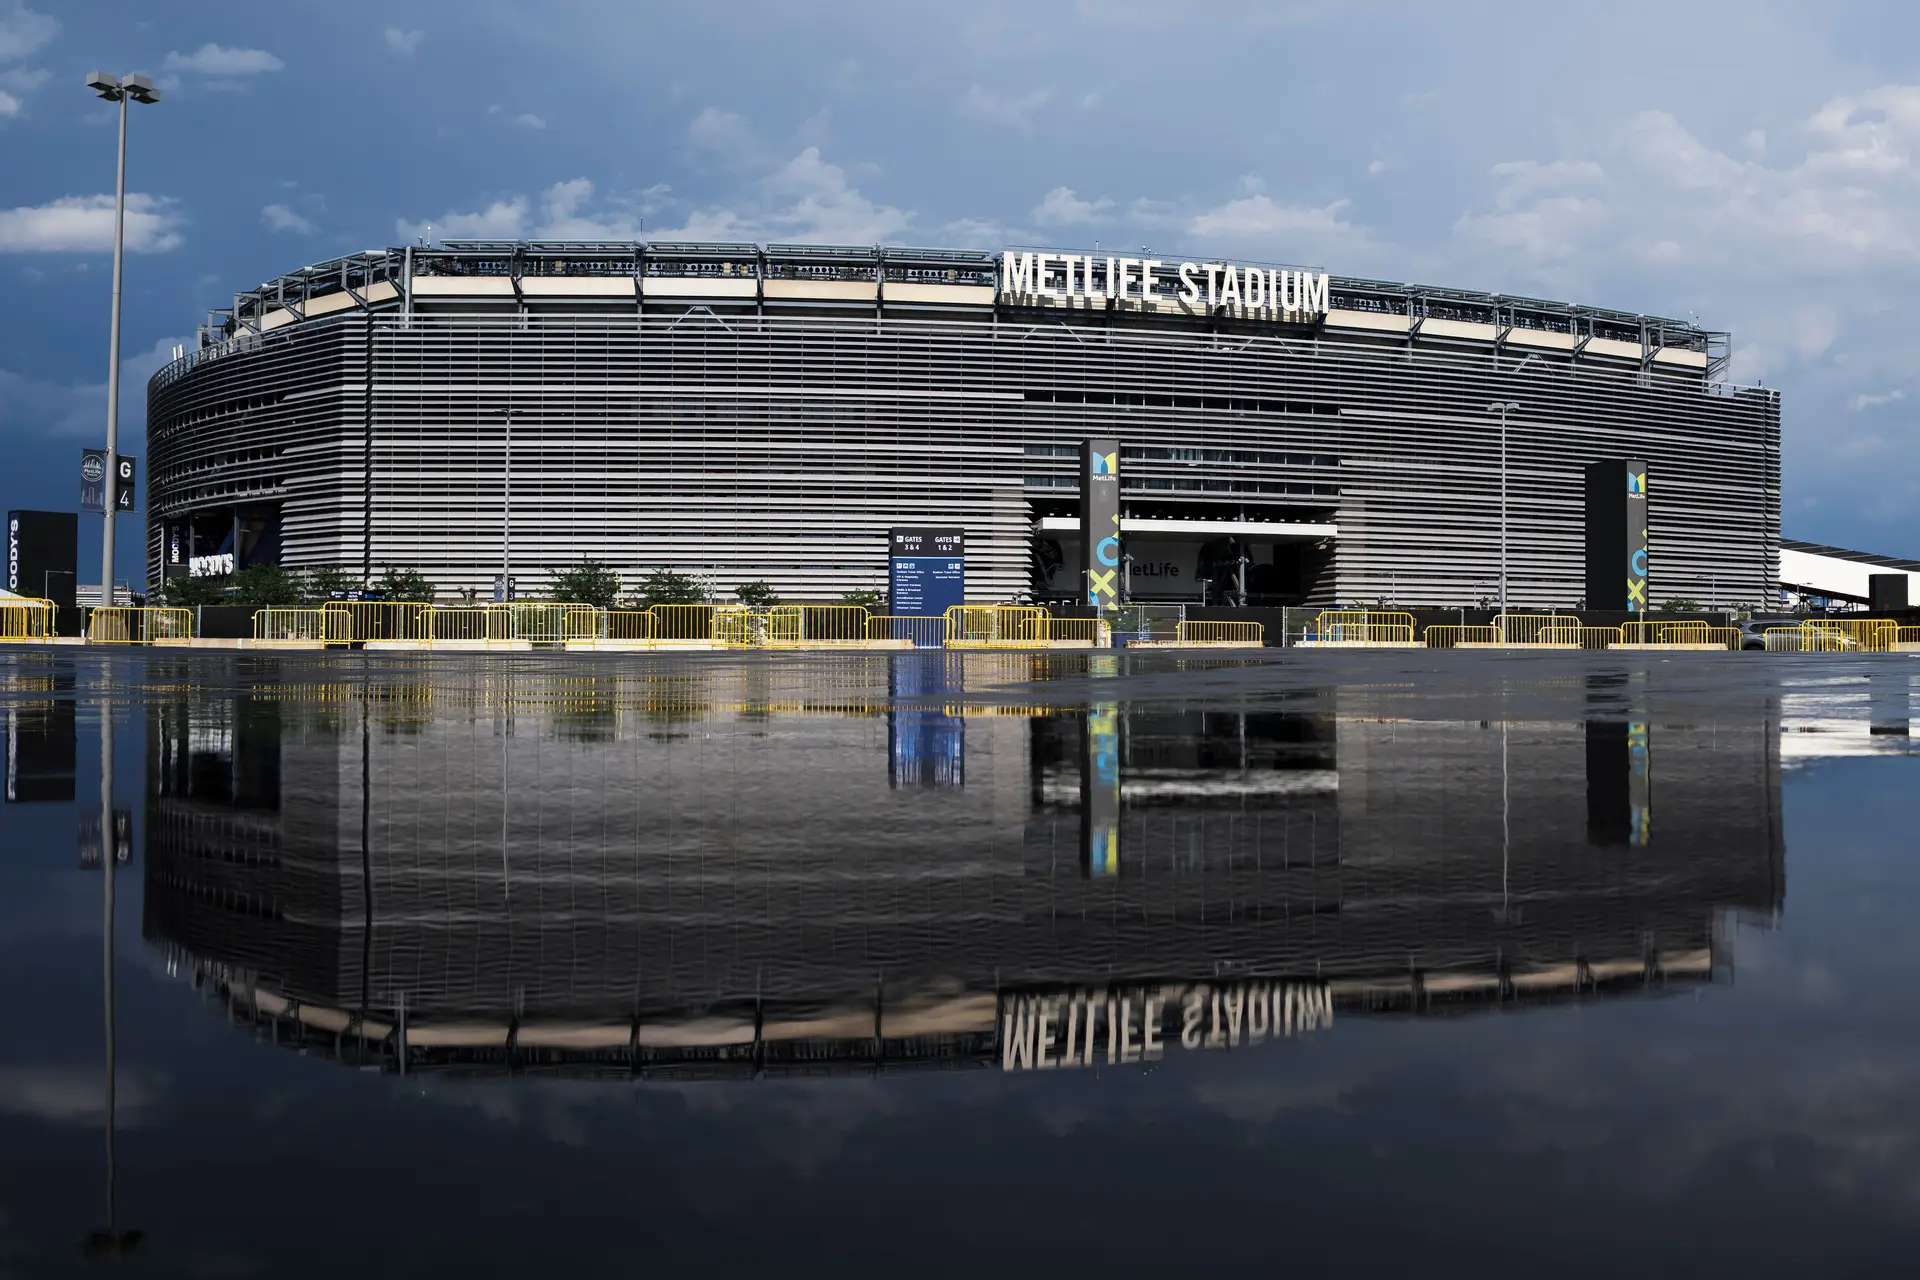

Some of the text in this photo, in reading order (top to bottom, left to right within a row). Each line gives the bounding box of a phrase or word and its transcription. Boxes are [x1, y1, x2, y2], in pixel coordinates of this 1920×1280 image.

[1002, 252, 1330, 314] METLIFE STADIUM
[120, 462, 131, 478] G
[120, 490, 129, 506] 4
[10, 519, 19, 590] OODY'S
[189, 553, 233, 577] MOODY'S
